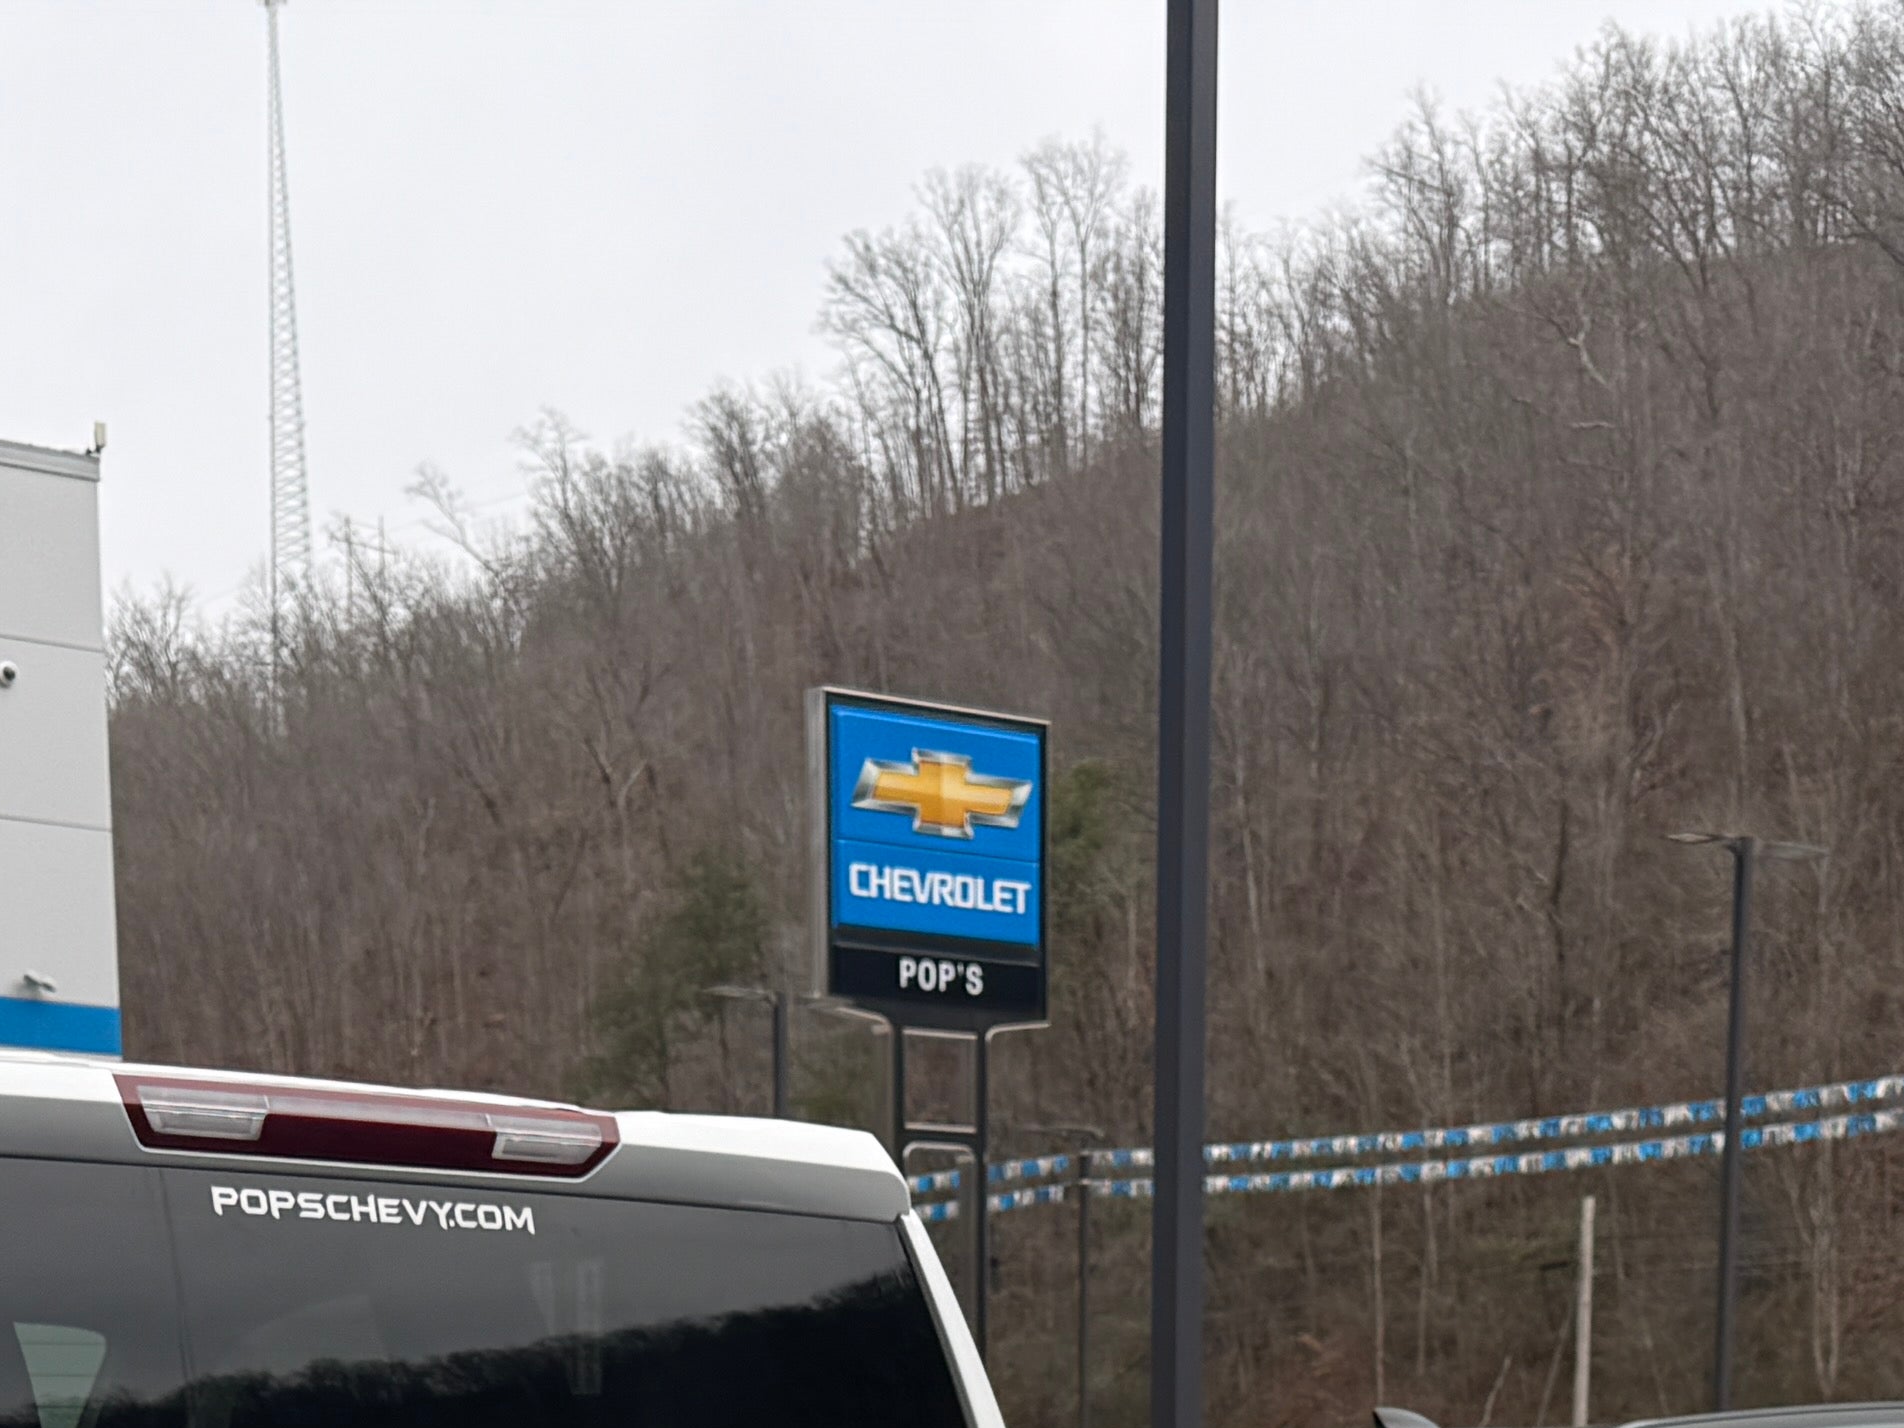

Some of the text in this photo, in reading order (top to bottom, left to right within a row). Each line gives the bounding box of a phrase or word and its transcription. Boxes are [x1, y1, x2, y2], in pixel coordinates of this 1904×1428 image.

[848, 861, 1032, 914] CHEVROLET
[899, 956, 984, 996] POP'S
[210, 1185, 536, 1236] POPSCHEVY.COM
